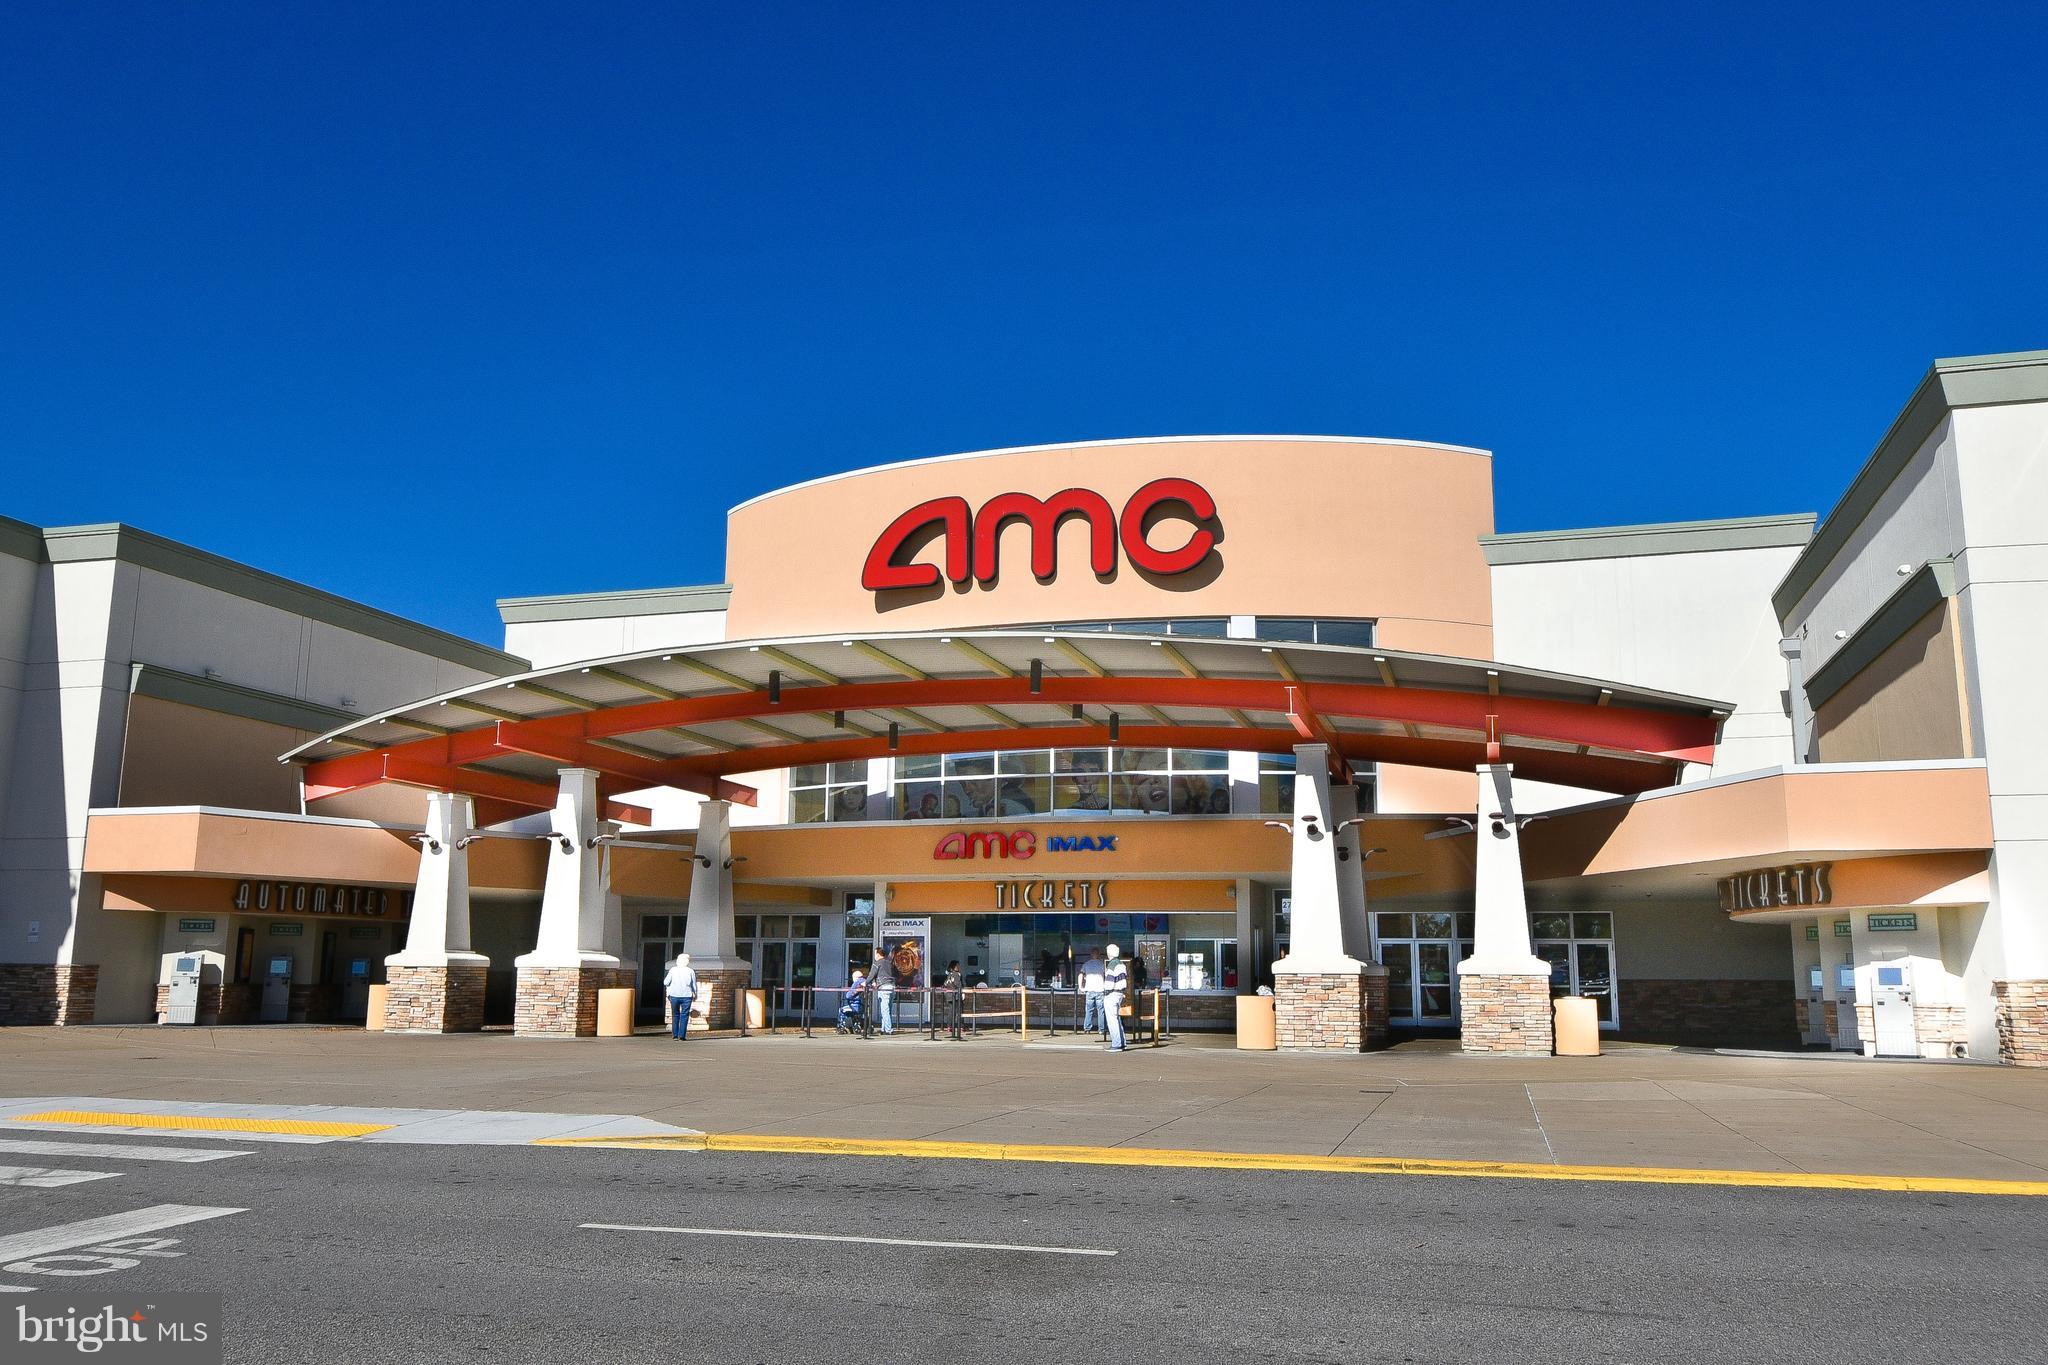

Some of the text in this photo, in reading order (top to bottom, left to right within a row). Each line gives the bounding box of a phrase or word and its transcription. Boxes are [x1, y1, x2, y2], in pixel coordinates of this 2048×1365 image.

[1046, 835, 1118, 852] IMAX
[235, 882, 388, 915] AUTOMATED
[994, 881, 1111, 909] TICKETS
[1729, 866, 1826, 912] TICKETS
